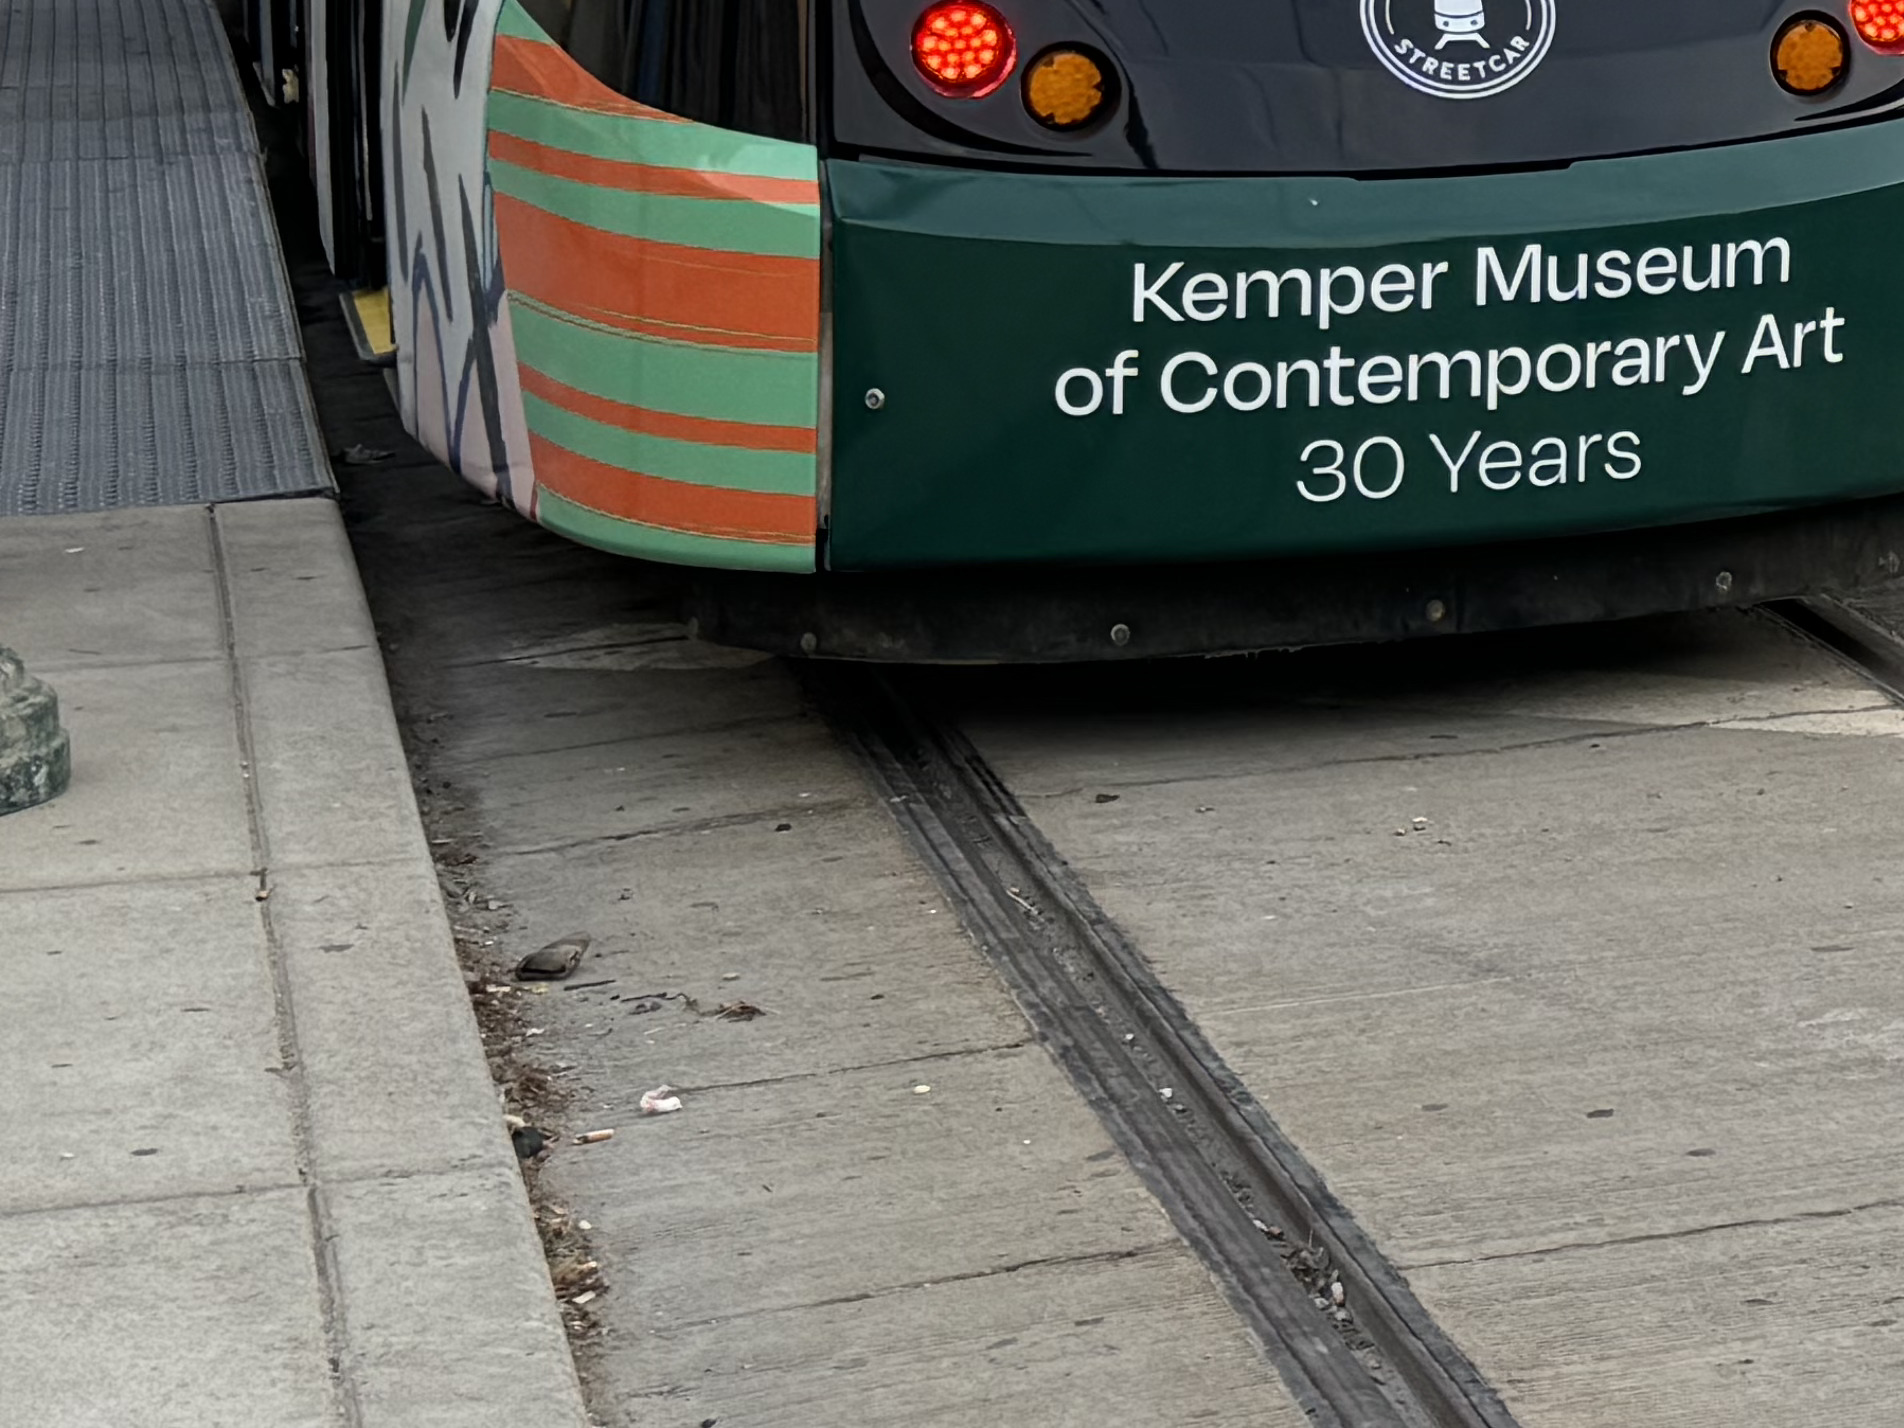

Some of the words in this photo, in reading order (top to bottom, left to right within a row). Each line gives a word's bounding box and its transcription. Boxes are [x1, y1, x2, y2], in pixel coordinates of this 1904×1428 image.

[1393, 34, 1530, 81] STREETCAR
[1132, 260, 1449, 331] Kemper
[1475, 235, 1792, 307] Museum
[1054, 349, 1140, 417] of
[1160, 330, 1727, 414] Contemporary
[1740, 306, 1846, 375] Art
[1296, 435, 1406, 503] 30
[1428, 429, 1642, 494] Years
